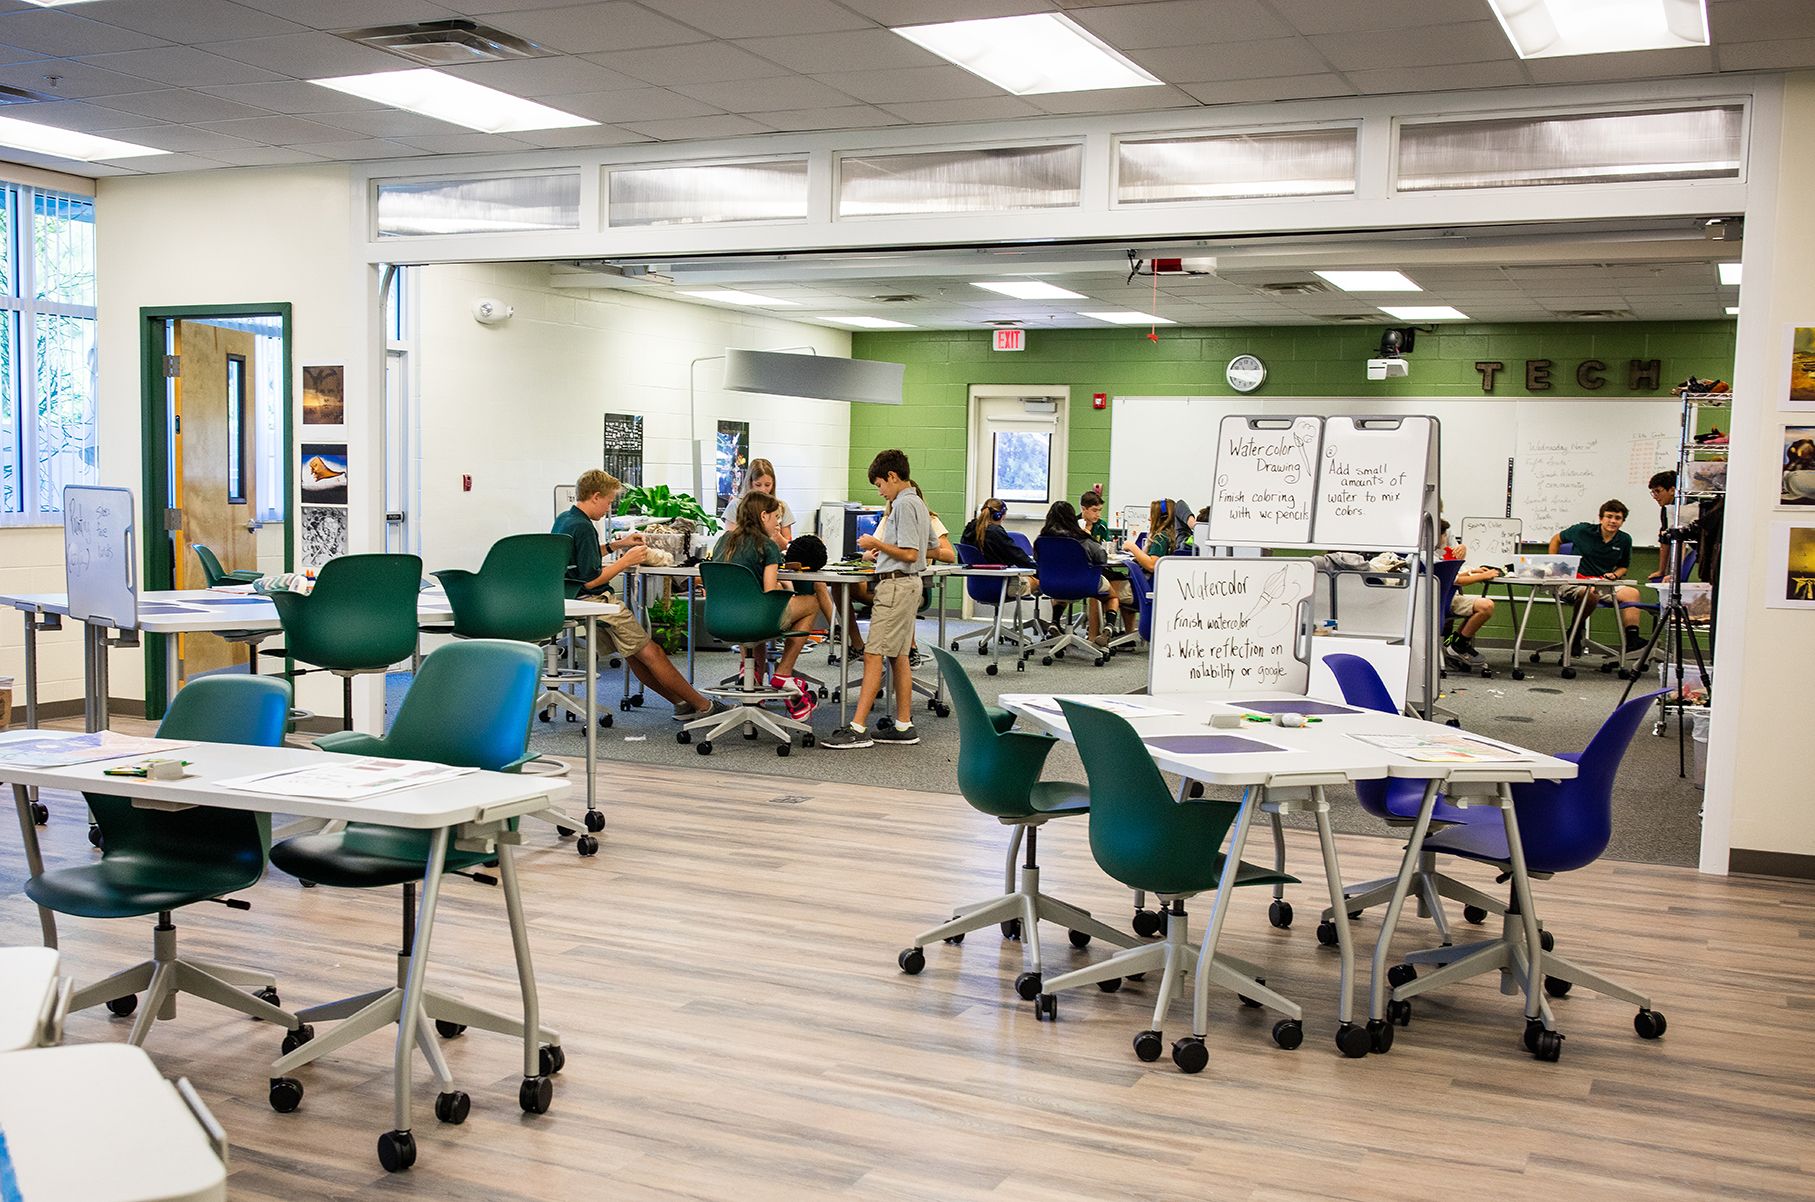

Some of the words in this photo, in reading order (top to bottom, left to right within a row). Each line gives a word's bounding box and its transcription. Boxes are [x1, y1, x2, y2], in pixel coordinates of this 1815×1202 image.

[997, 331, 1020, 349] EXIT
[1230, 436, 1295, 457] Watercolor
[1257, 457, 1300, 484] Drawing
[1328, 458, 1350, 475] Add
[1356, 463, 1387, 475] small
[1341, 475, 1384, 487] amounts
[1389, 471, 1407, 486] of
[1219, 489, 1245, 502] Finish
[1252, 488, 1296, 509] coloring
[1327, 489, 1357, 503] water
[1366, 491, 1376, 503] to
[1382, 492, 1401, 501] mix
[1229, 506, 1251, 519] with
[1259, 510, 1272, 519] wc
[1275, 501, 1309, 525] pencils
[1335, 505, 1363, 516] colors
[1177, 569, 1249, 600] Watercolor
[1174, 608, 1203, 630] Finish
[1207, 612, 1251, 630] watercolor
[1164, 643, 1175, 658] 2.
[1179, 639, 1205, 659] Write
[1210, 636, 1264, 659] reflection
[1271, 644, 1283, 655] on
[1189, 660, 1235, 689] notability
[1241, 667, 1252, 677] or
[1257, 660, 1287, 684] google
